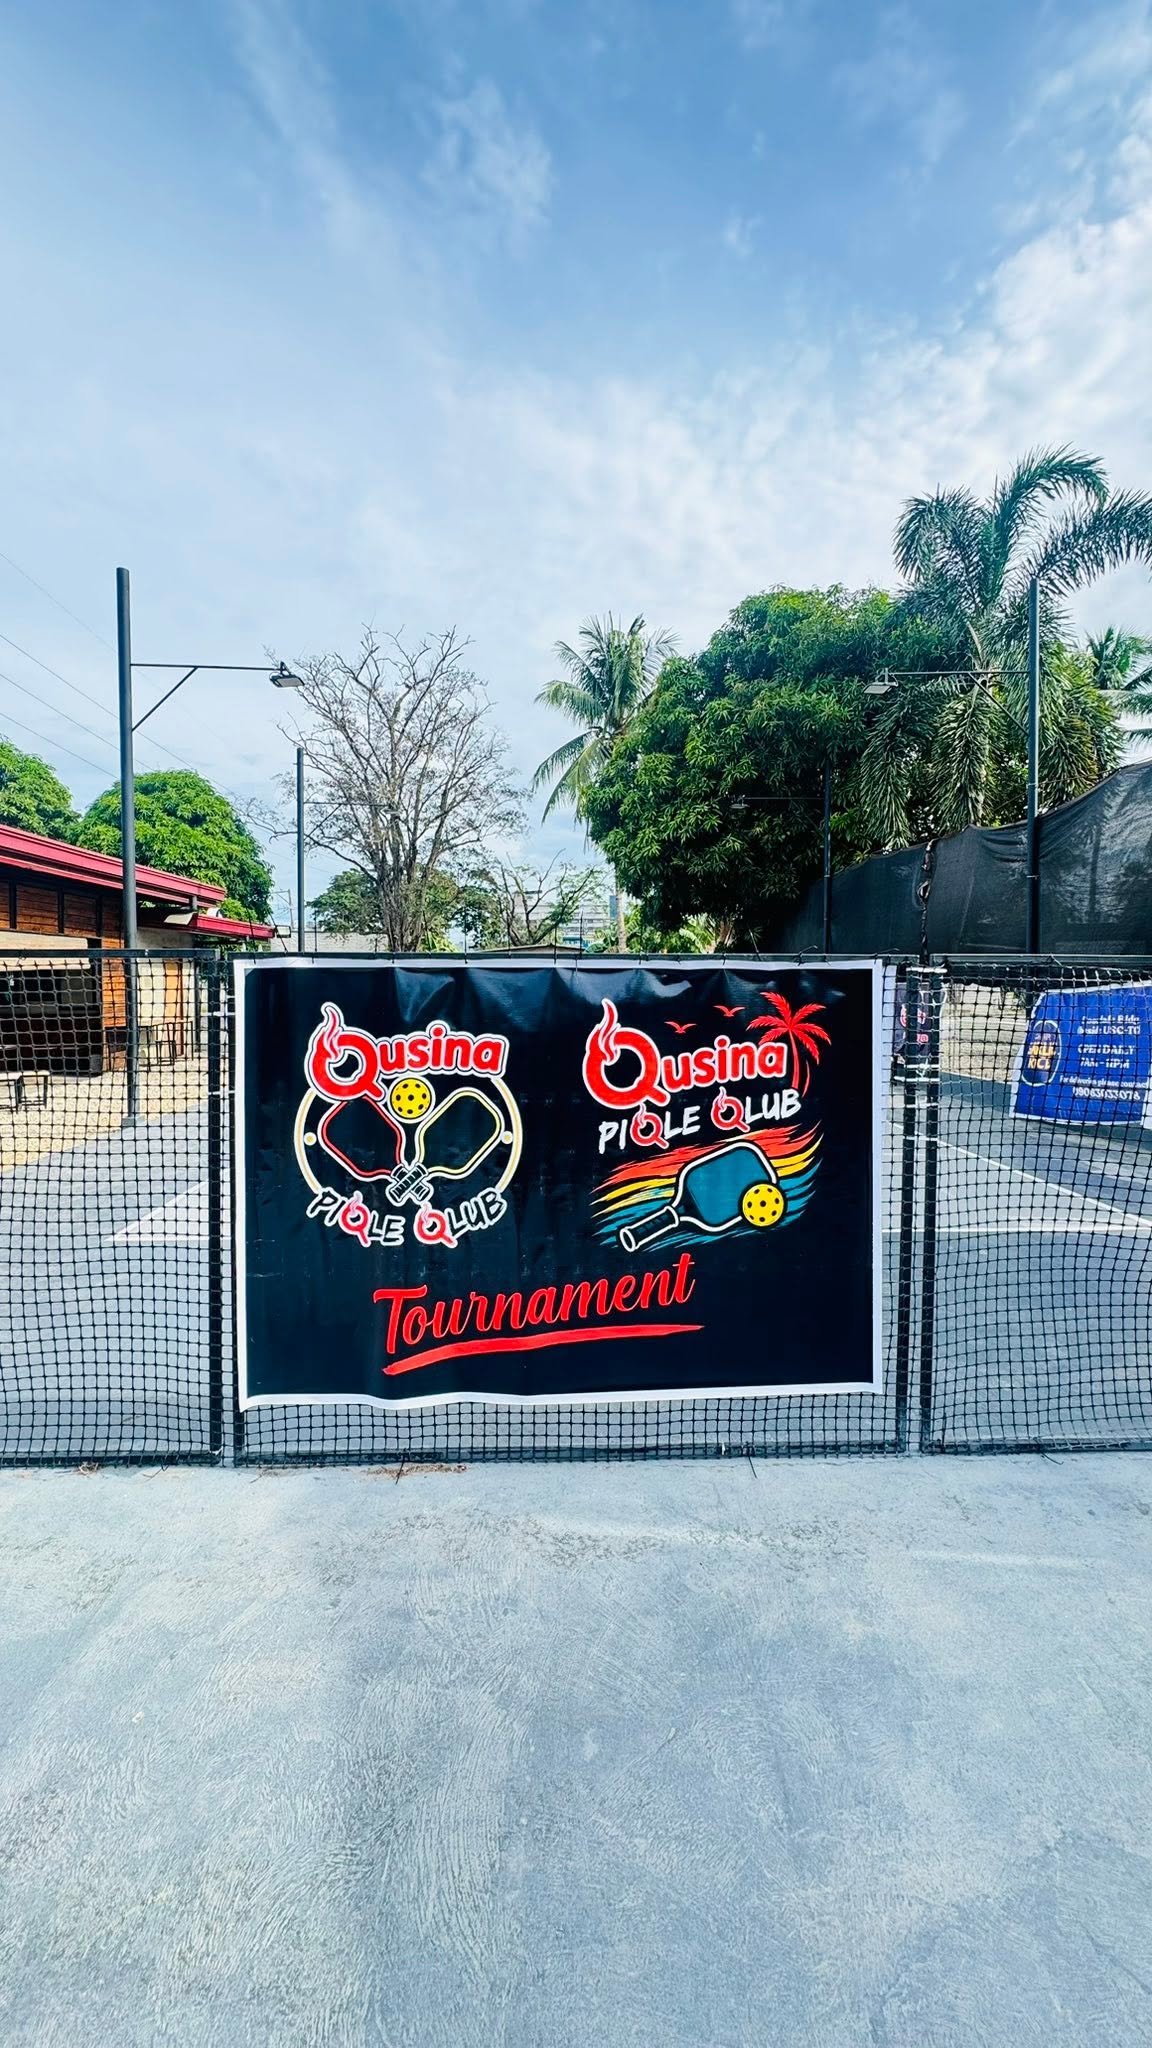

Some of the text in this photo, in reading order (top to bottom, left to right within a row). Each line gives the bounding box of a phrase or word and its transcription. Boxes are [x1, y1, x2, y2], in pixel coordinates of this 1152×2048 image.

[304, 1002, 510, 1104] Qusina
[582, 998, 788, 1110] Qusina
[598, 1086, 802, 1155] PIQLE QLUB
[306, 1187, 507, 1248] PIQLE QLUB
[373, 1252, 696, 1354] Tournament
